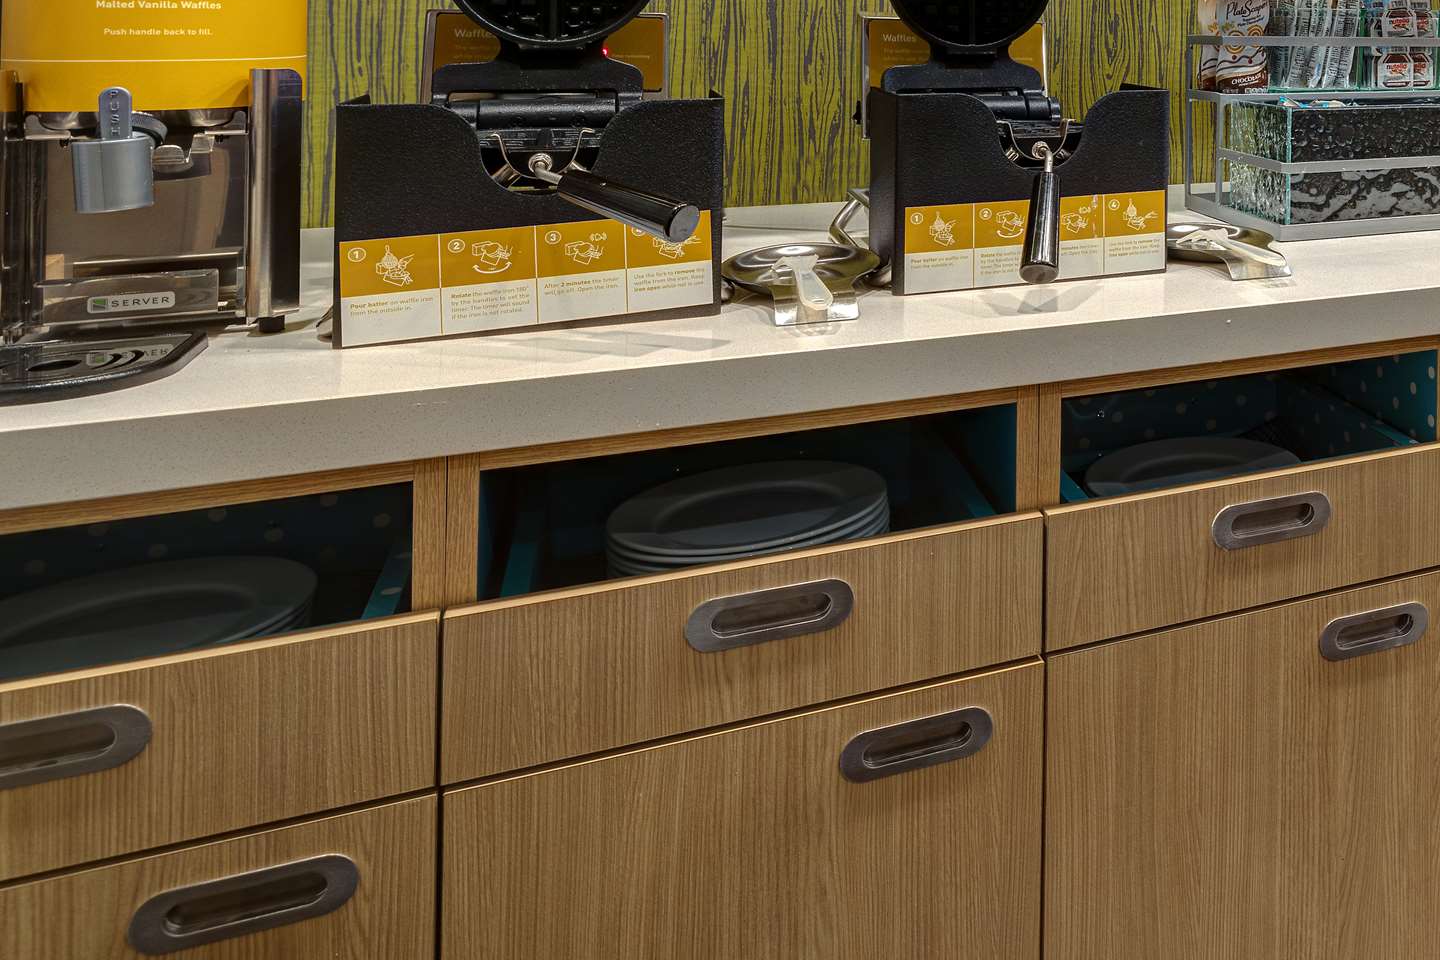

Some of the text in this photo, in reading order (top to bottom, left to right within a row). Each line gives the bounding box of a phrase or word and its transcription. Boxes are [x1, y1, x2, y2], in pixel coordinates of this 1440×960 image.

[96, 0, 221, 10] Malted Vanilla Waffles
[454, 28, 495, 39] Waffle
[451, 291, 472, 299] Rotate
[111, 296, 170, 308] SERVER
